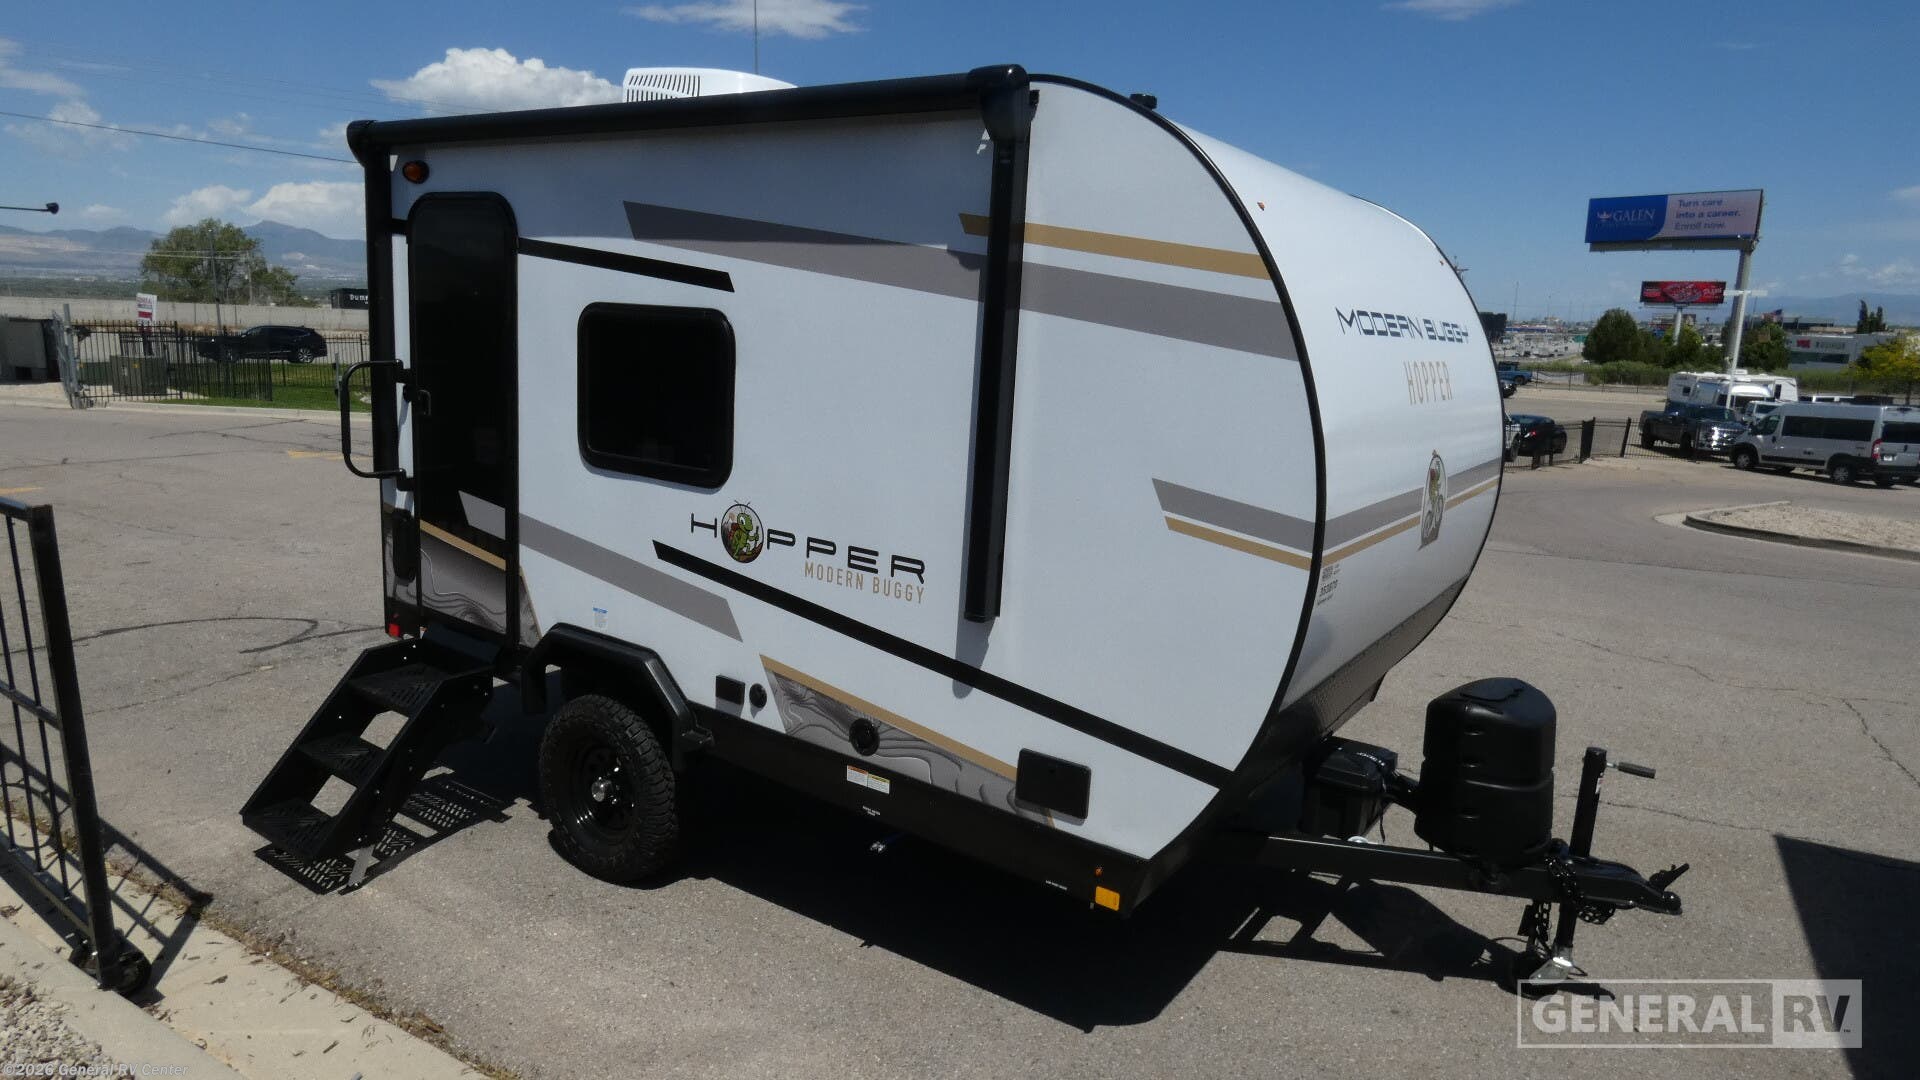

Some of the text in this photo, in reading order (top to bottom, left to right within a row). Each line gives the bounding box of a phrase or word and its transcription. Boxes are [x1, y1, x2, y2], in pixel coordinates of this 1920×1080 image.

[1678, 199, 1723, 208] Turn care
[1612, 208, 1656, 222] GALEN
[1675, 210, 1696, 219] into
[1706, 209, 1742, 218] career.
[1674, 221, 1702, 231] Enroll
[1335, 306, 1469, 345] MODERN BUGGY
[1403, 361, 1453, 405] HOPPER
[804, 561, 925, 604] MODERN BUGGY
